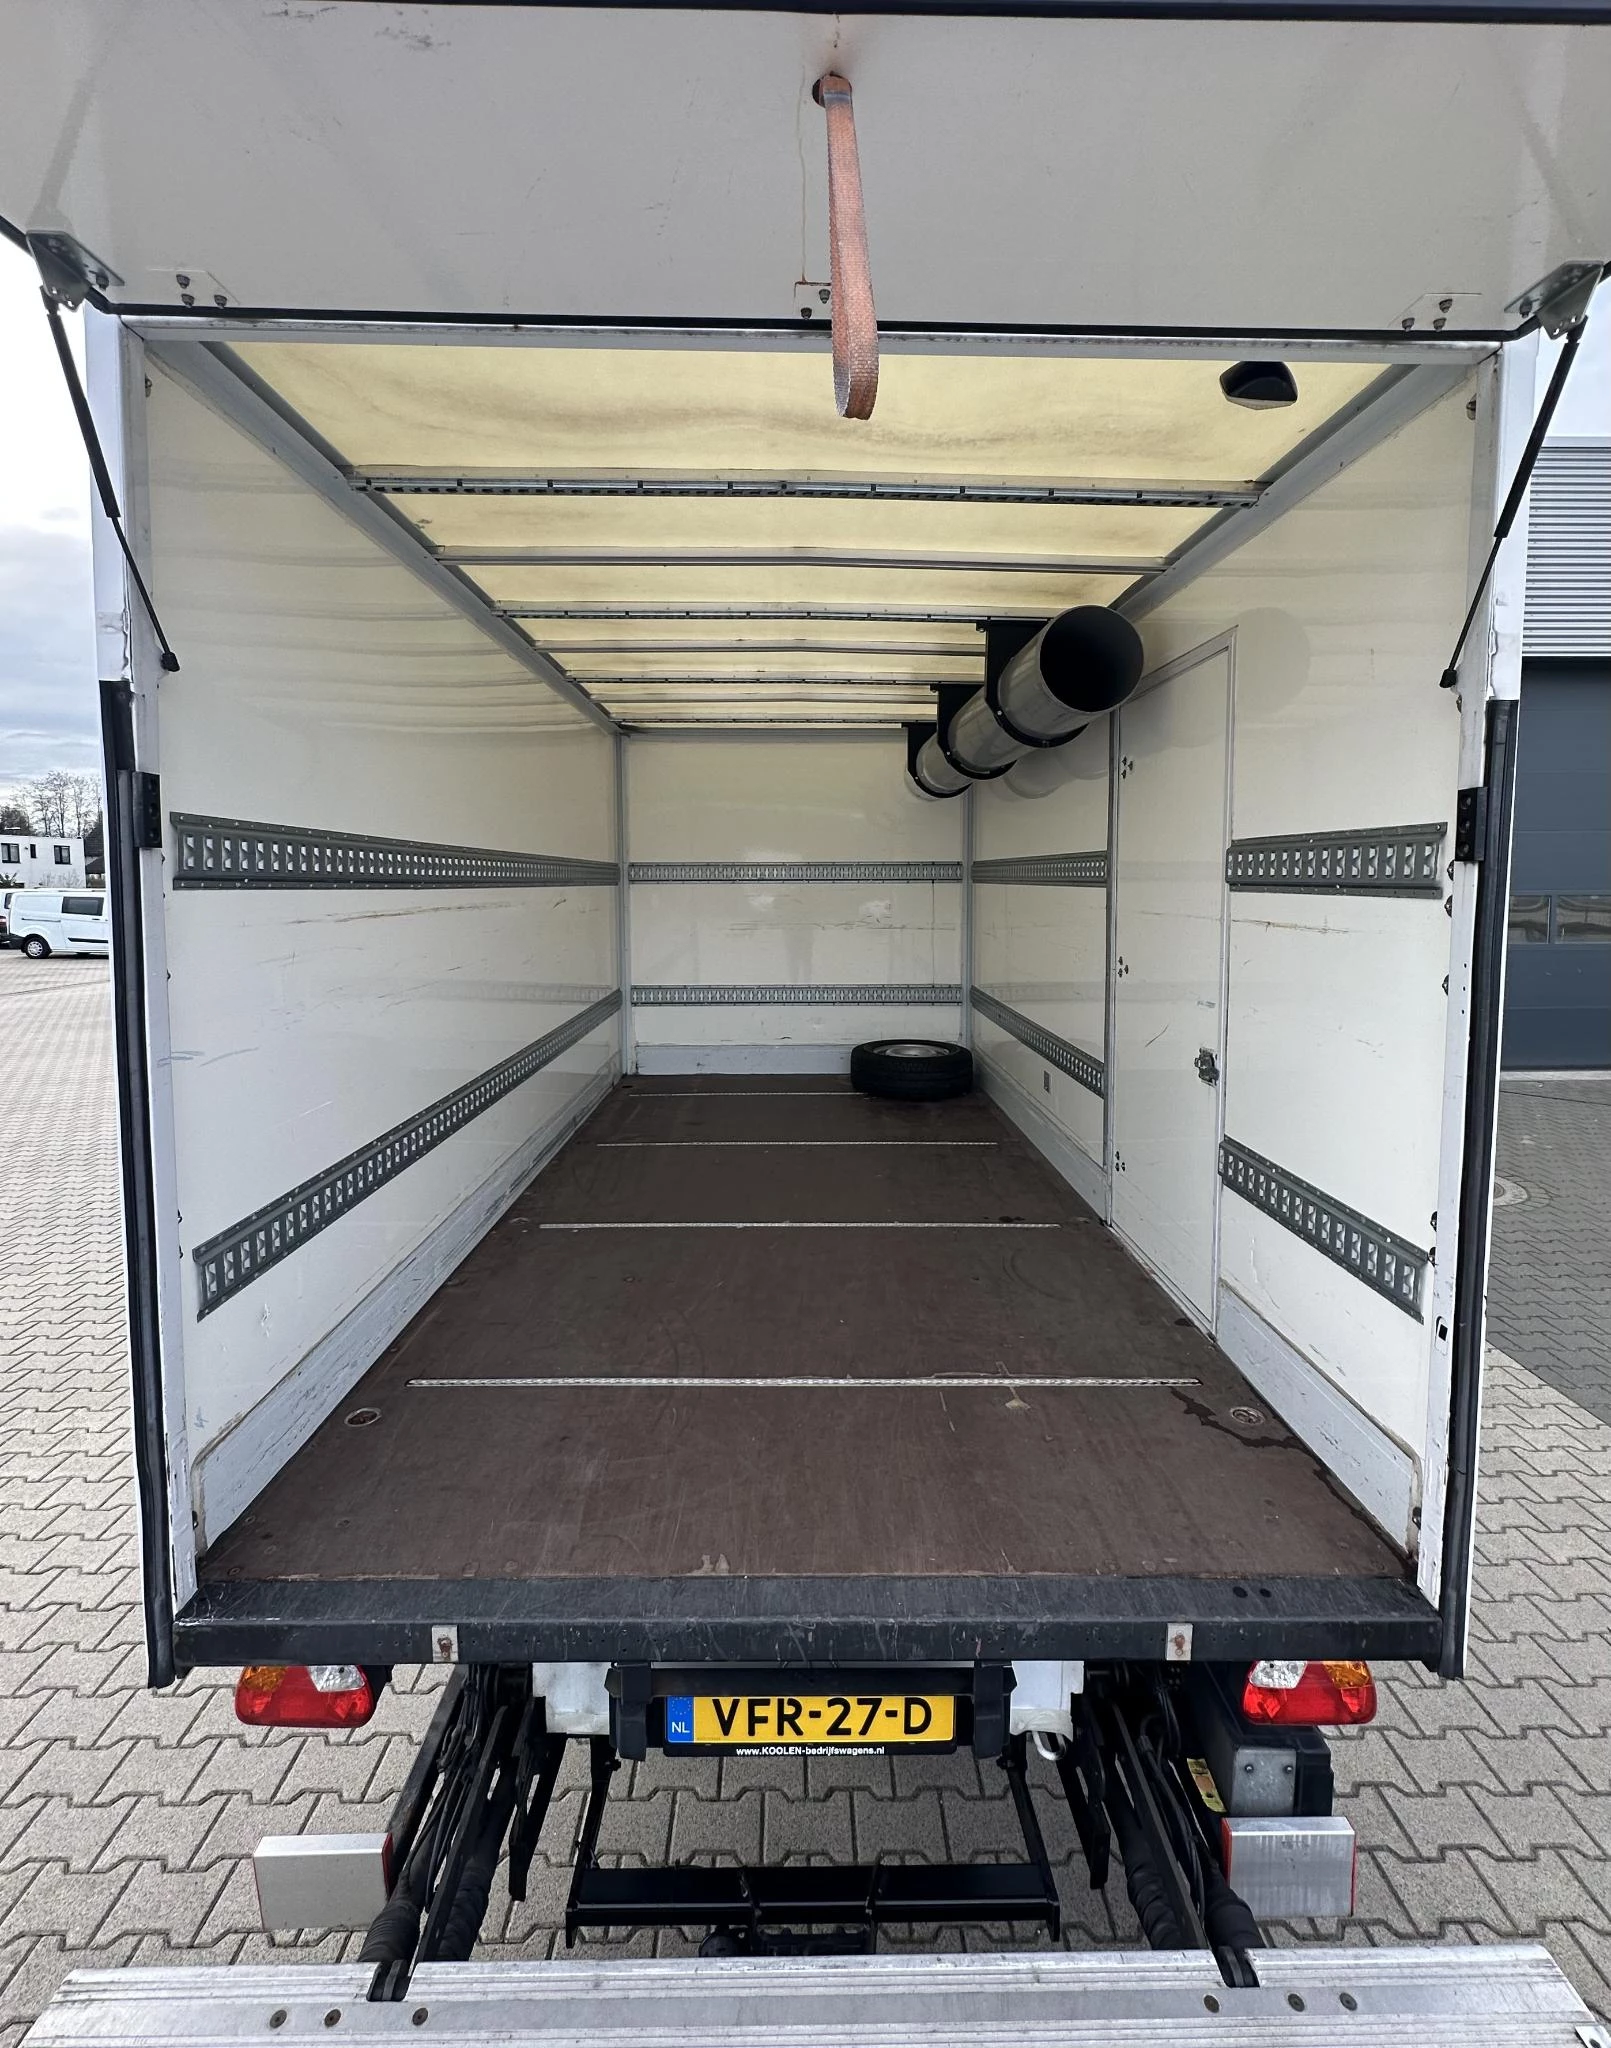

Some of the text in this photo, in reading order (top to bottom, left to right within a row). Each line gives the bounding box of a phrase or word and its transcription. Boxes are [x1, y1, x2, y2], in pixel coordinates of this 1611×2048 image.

[711, 1697, 932, 1737] VFR-27-D
[671, 1721, 690, 1733] NL
[736, 1746, 885, 1756] www.KOOLEN-bedrijfswagens.nl
